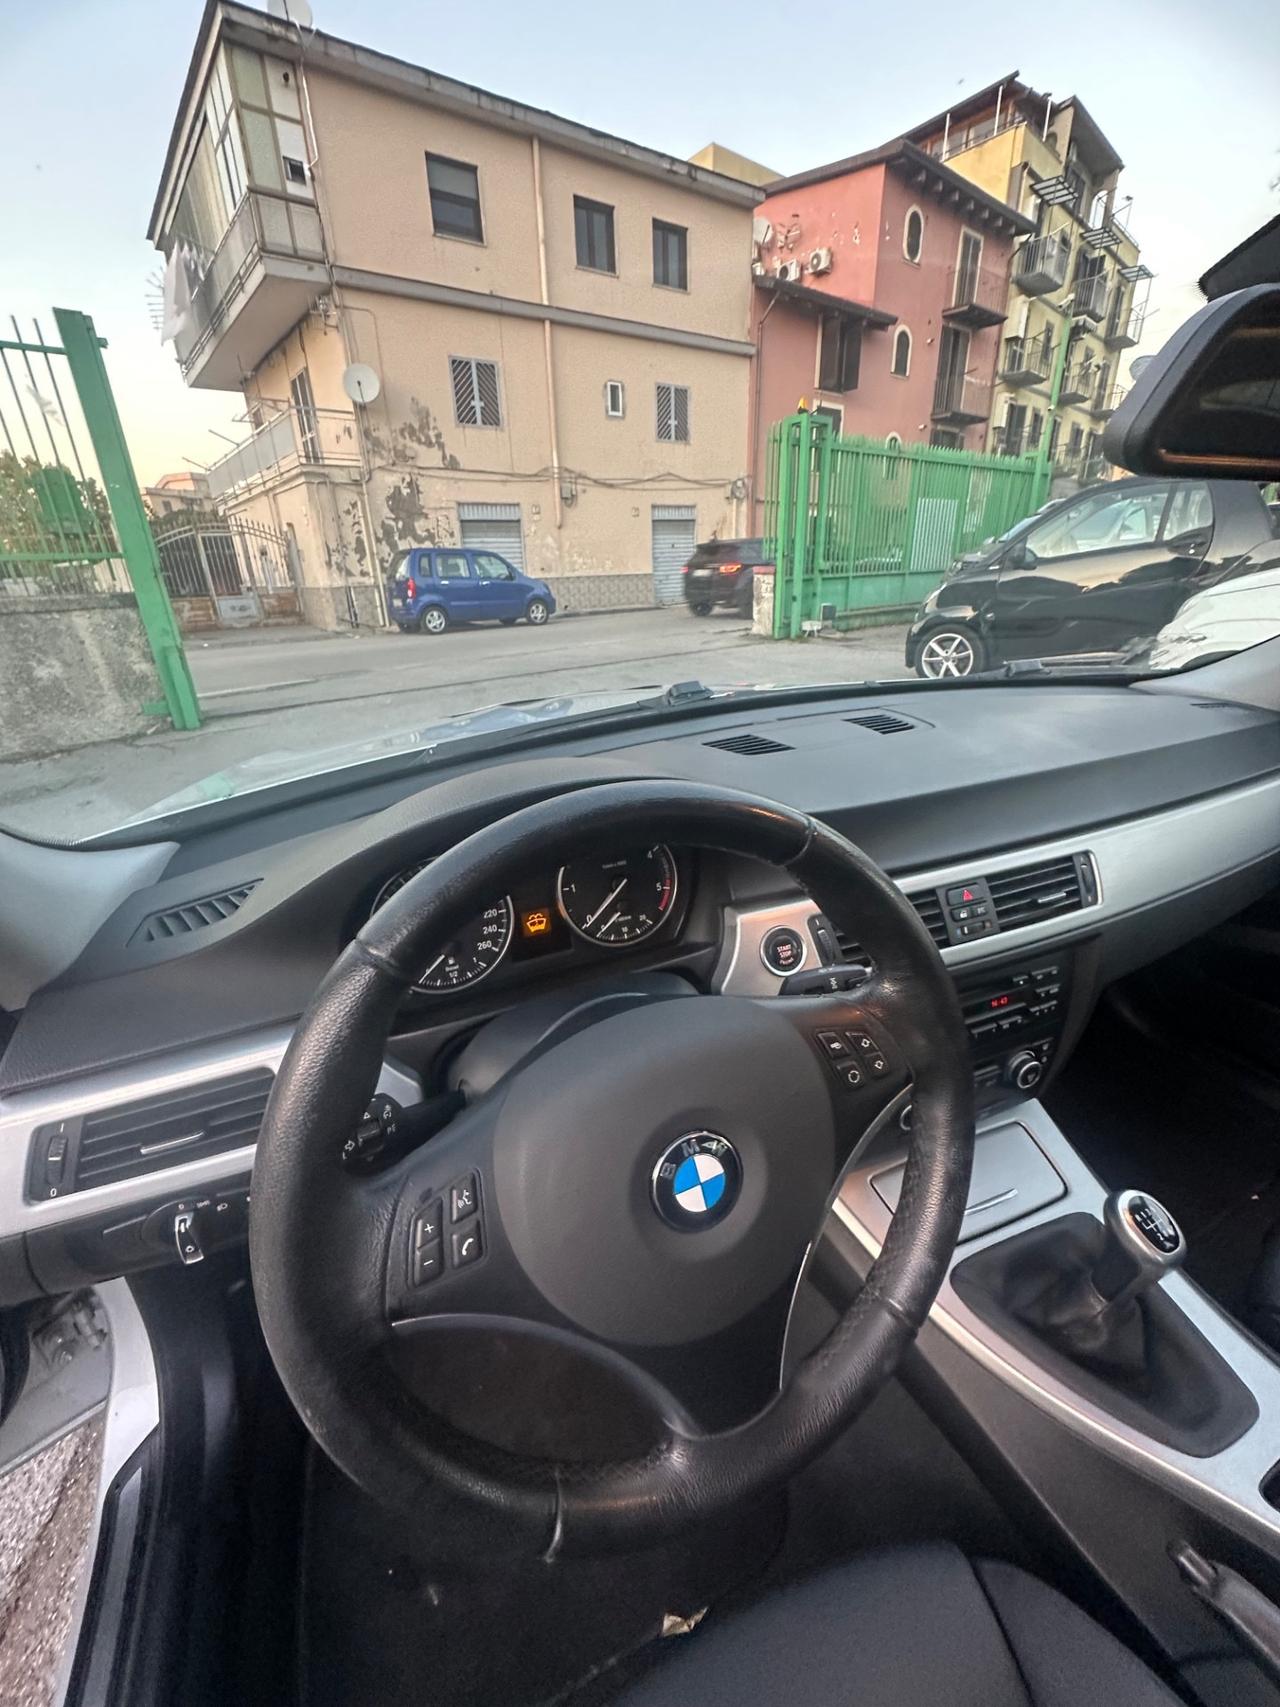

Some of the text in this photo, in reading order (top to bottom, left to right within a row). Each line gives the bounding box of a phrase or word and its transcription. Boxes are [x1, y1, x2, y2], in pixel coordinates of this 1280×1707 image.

[656, 882, 662, 891] 5
[482, 924, 498, 934] 240
[476, 940, 492, 951] 260
[660, 1138, 728, 1180] BMW
